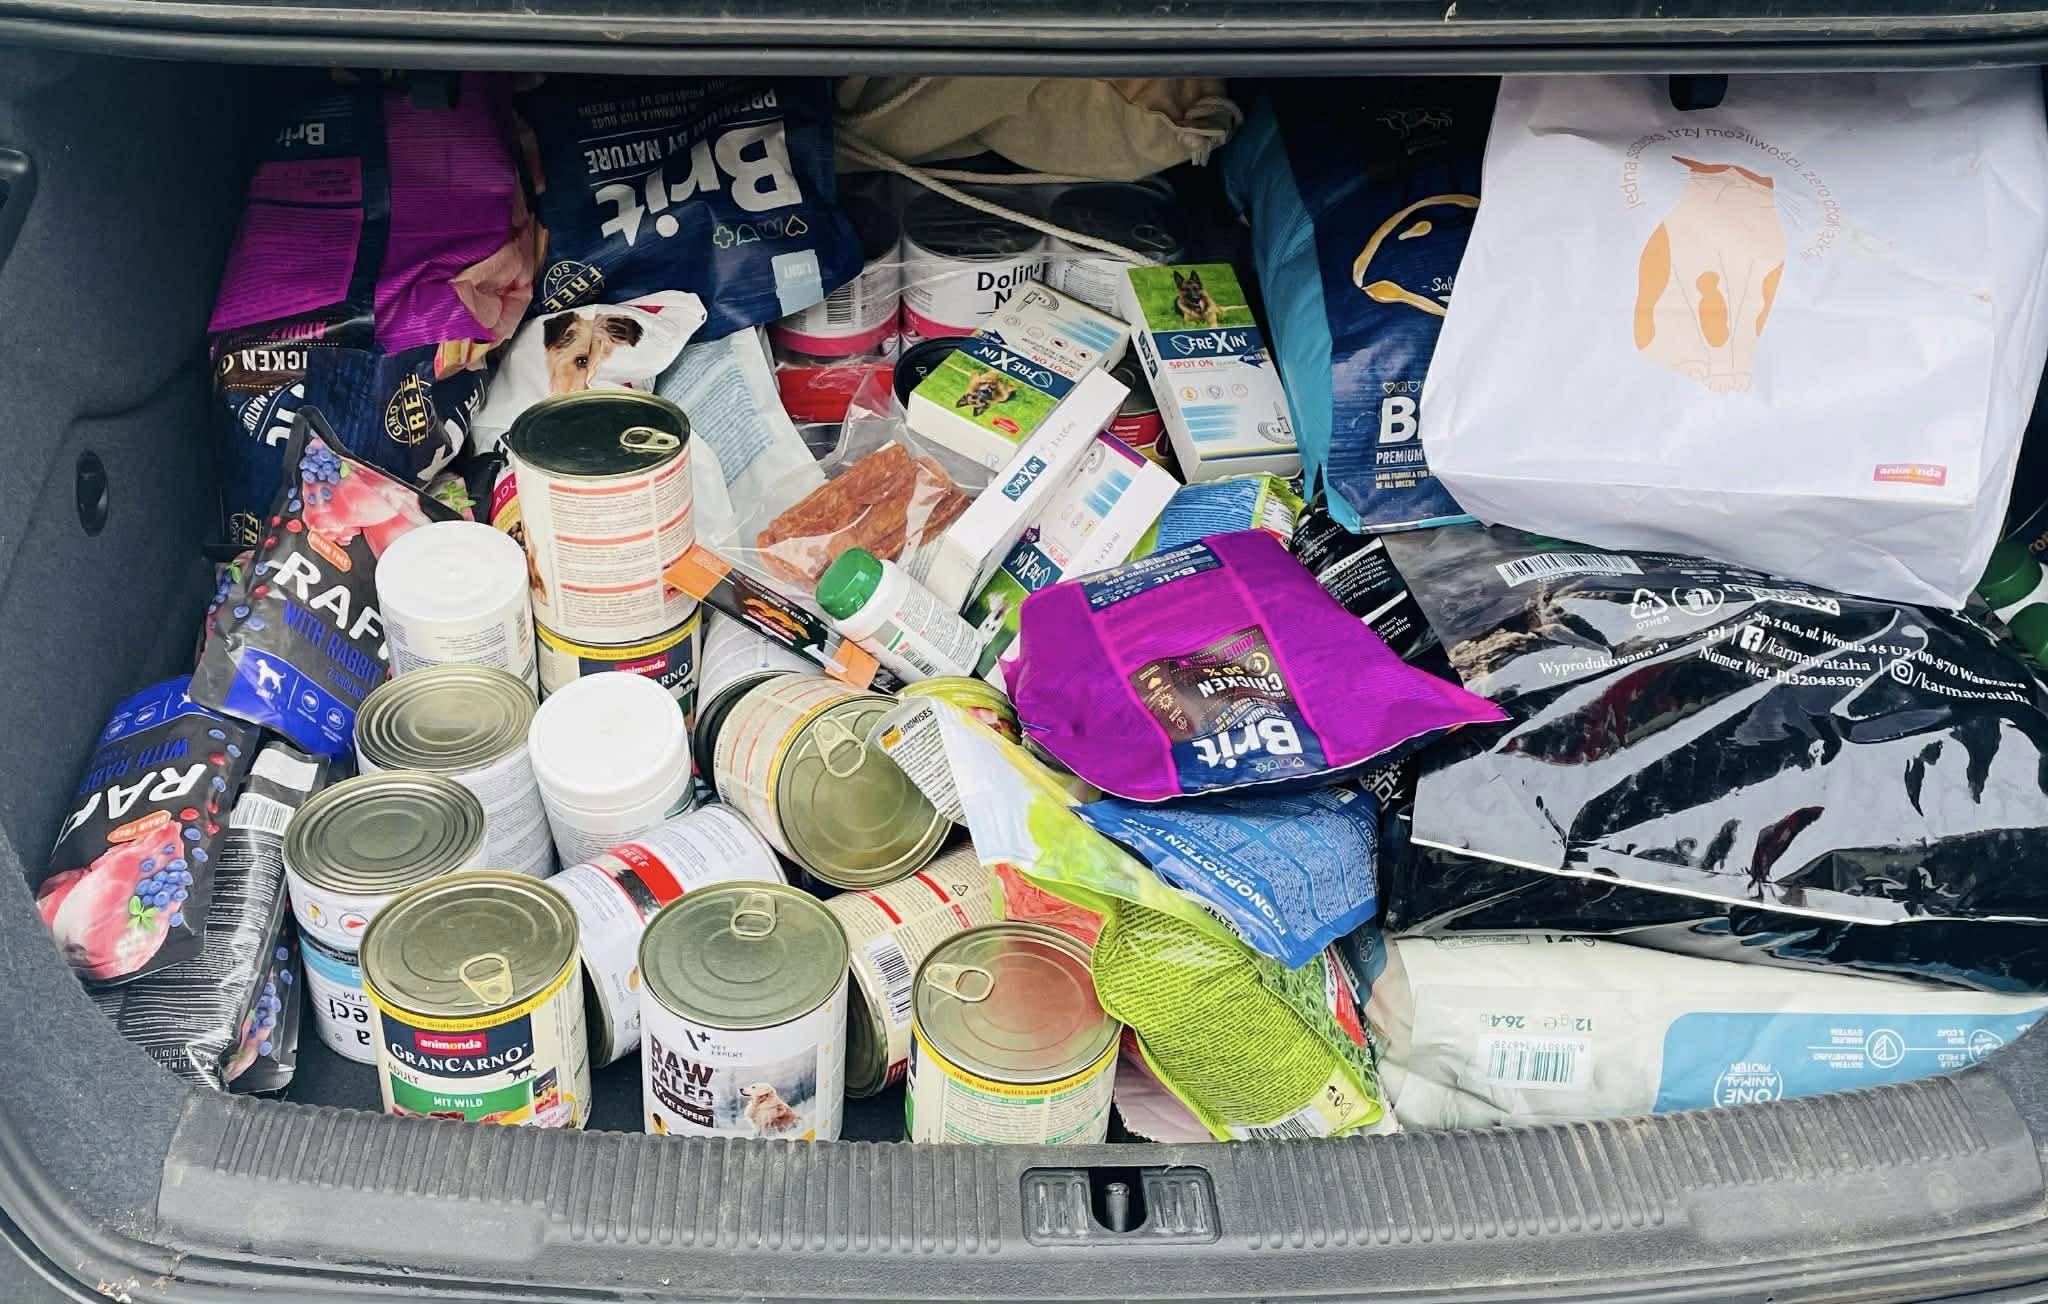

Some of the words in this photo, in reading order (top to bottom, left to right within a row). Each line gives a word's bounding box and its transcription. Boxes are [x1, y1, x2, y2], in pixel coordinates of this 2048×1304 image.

[584, 137, 662, 174] NATURE
[595, 119, 803, 247] Brit
[548, 263, 571, 285] SOY
[544, 265, 604, 312] FREE
[1168, 361, 1196, 369] SPOT
[1199, 360, 1214, 368] ON
[242, 394, 269, 437] NATUR
[404, 373, 426, 446] FREE
[1376, 451, 1423, 465] PREMIUM
[1385, 481, 1394, 489] ALL
[1152, 566, 1198, 584] Brit
[1639, 600, 1654, 610] 07
[1636, 615, 1672, 631] OTHER
[284, 600, 327, 648] WITH
[326, 631, 383, 688] RABBIT
[1753, 611, 1773, 627] Sp.
[1806, 630, 1821, 642] ul.
[1822, 630, 1867, 653] Wronia
[1868, 644, 1887, 655] 45
[1890, 645, 1915, 661] U2,
[1918, 650, 1959, 677] 00-870
[1960, 667, 2028, 689] Warszawa
[1698, 645, 1744, 671] Numer
[1744, 661, 1772, 681] Wet.
[1197, 672, 1284, 698] CHICKEN
[136, 738, 189, 769] WITH
[1191, 718, 1304, 769] Brit
[617, 848, 650, 867] BEEF
[1164, 833, 1287, 936] MONOPROTEIN
[1490, 1015, 1526, 1029] 26.4
[420, 1038, 483, 1050] animonda
[650, 1032, 714, 1088] RAW
[1730, 1062, 1773, 1073] PROTEIN
[388, 1060, 420, 1085] ADULT
[1723, 1075, 1777, 1087] ANIMAL
[433, 1095, 452, 1107] MIT
[454, 1097, 484, 1108] WILD
[1003, 1087, 1025, 1096] with
[1723, 1089, 1773, 1105] ONE
[663, 1097, 678, 1110] VET
[676, 1102, 711, 1125] EXPERT
